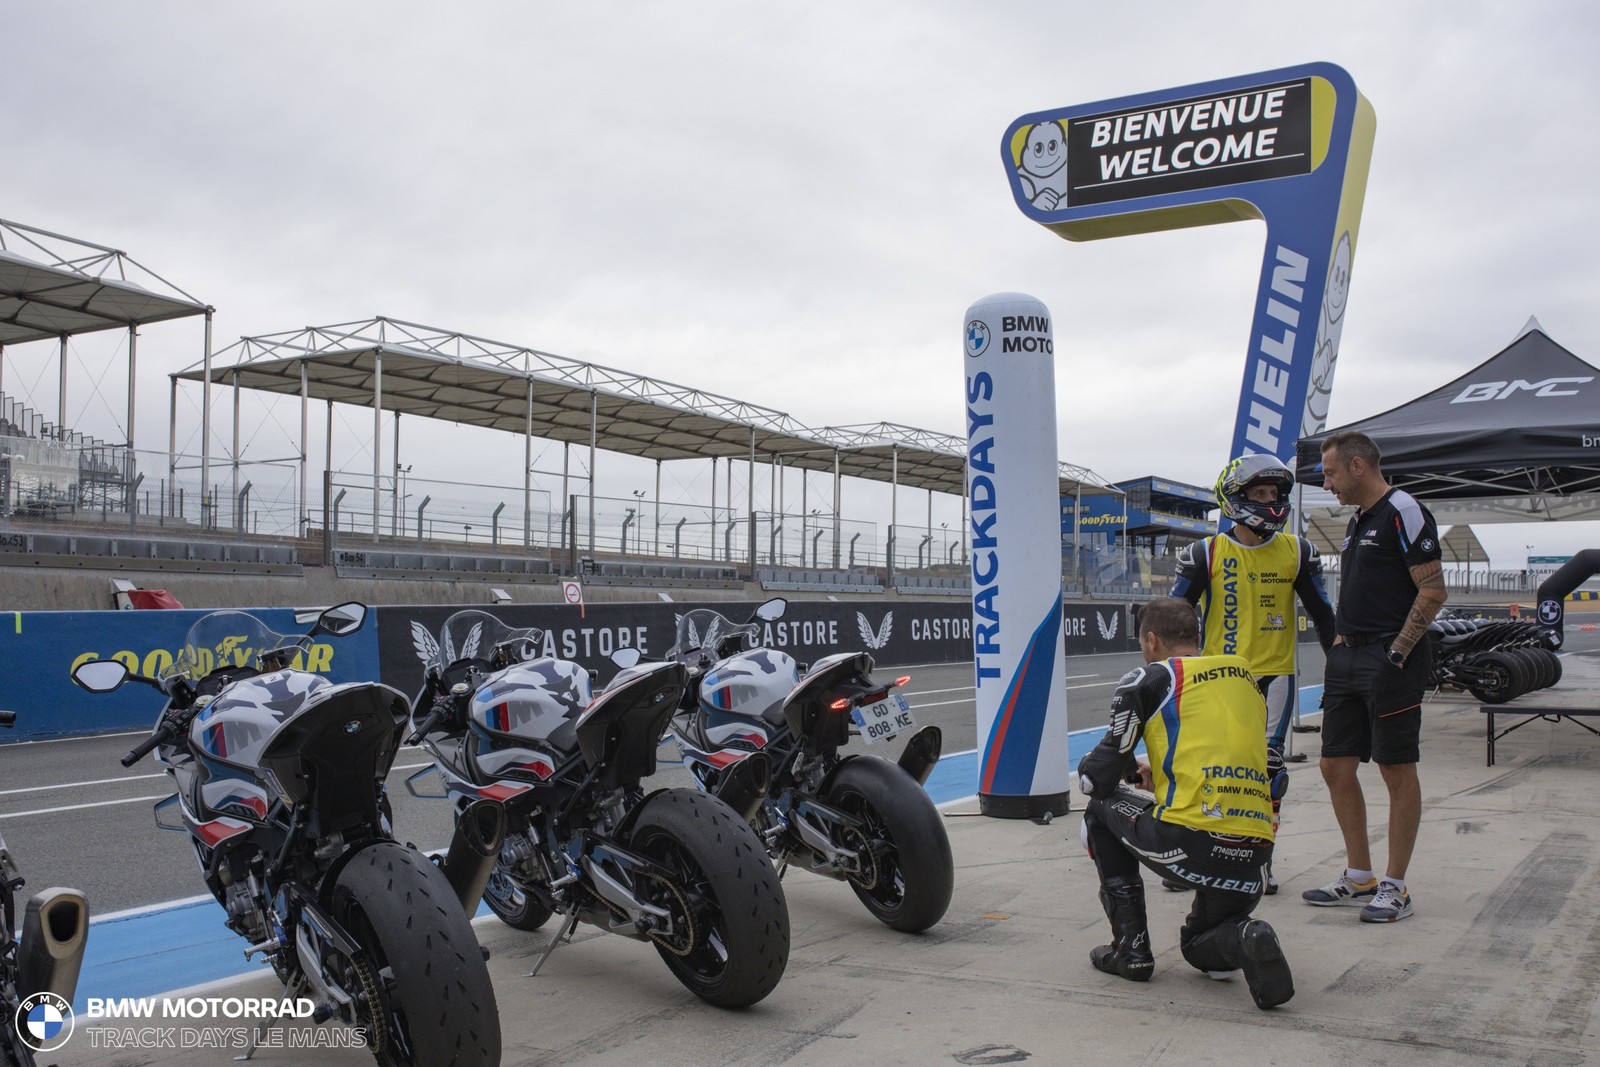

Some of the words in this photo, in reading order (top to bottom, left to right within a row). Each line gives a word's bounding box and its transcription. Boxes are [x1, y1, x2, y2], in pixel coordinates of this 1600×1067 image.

[1091, 90, 1287, 148] BIENVENUE
[1100, 127, 1278, 181] WELCOME
[1002, 315, 1049, 333] BMW
[1242, 244, 1310, 456] HELIN
[1450, 376, 1595, 404] BMC
[966, 371, 1001, 688] TRACKDAYS
[1223, 557, 1239, 656] RACKDAYS
[749, 620, 838, 648] CASTORE
[872, 703, 889, 718] GD
[1217, 786, 1241, 794] BMW
[1166, 863, 1213, 885] ALEX
[1211, 877, 1261, 895] LELEU
